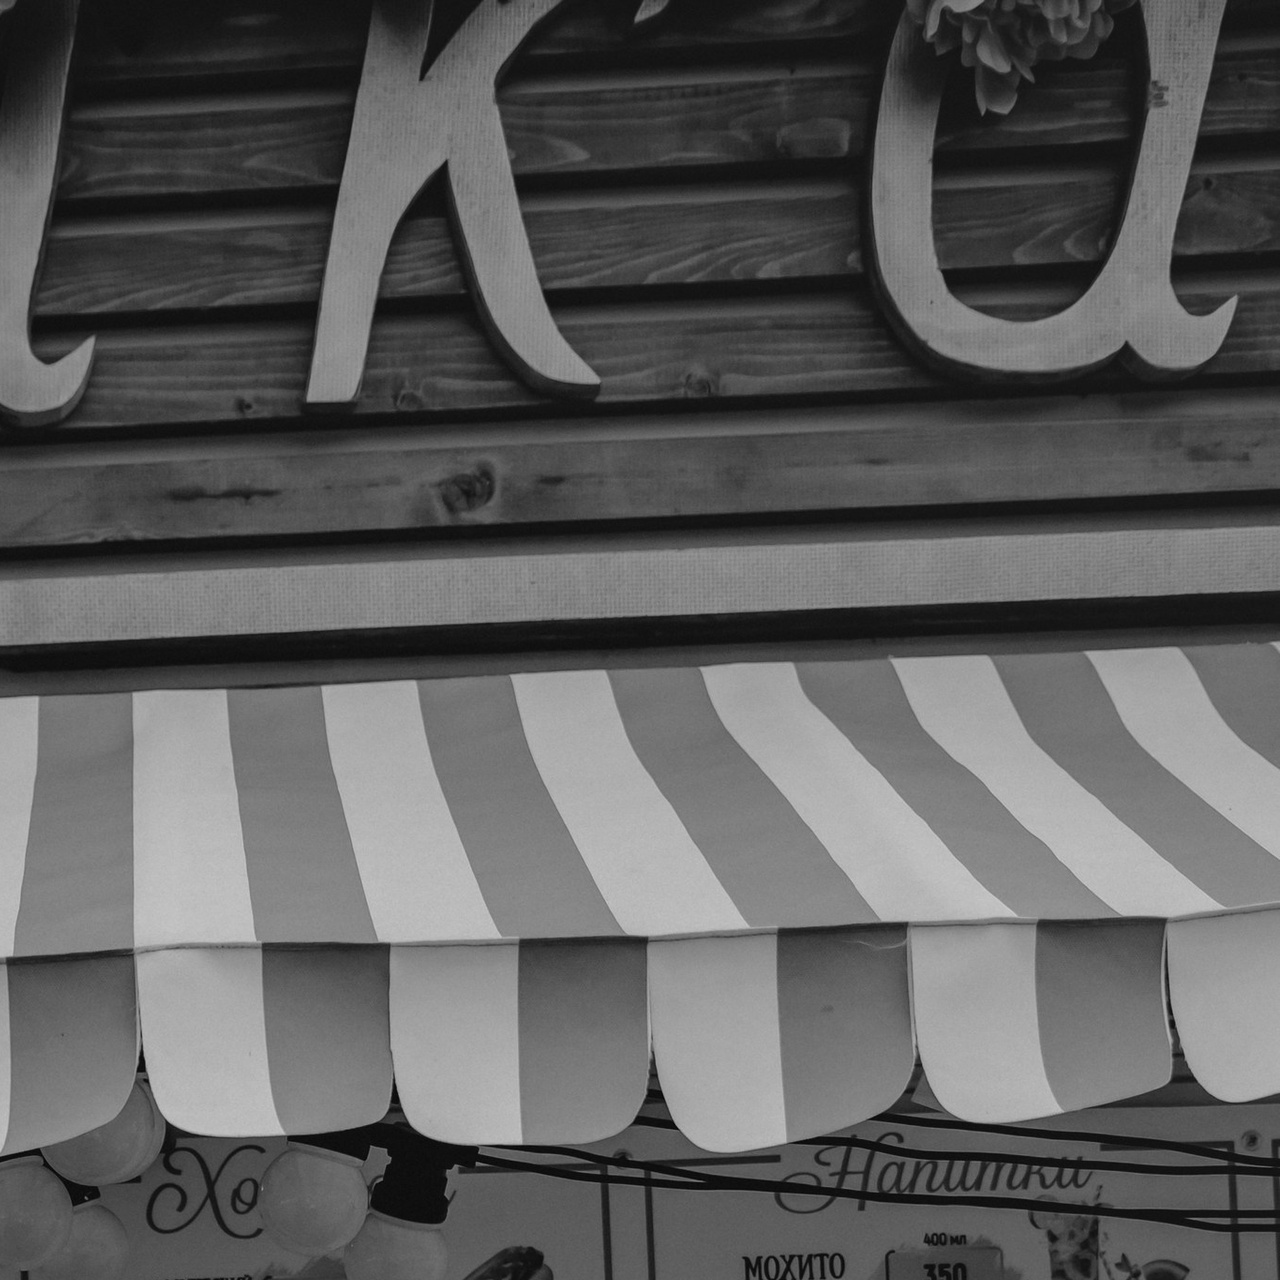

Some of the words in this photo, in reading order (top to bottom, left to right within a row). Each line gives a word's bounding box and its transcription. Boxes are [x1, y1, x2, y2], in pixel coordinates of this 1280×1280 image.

[774, 1132, 1094, 1215] Напитки
[924, 1233, 950, 1247] 400
[948, 1233, 967, 1247] мл
